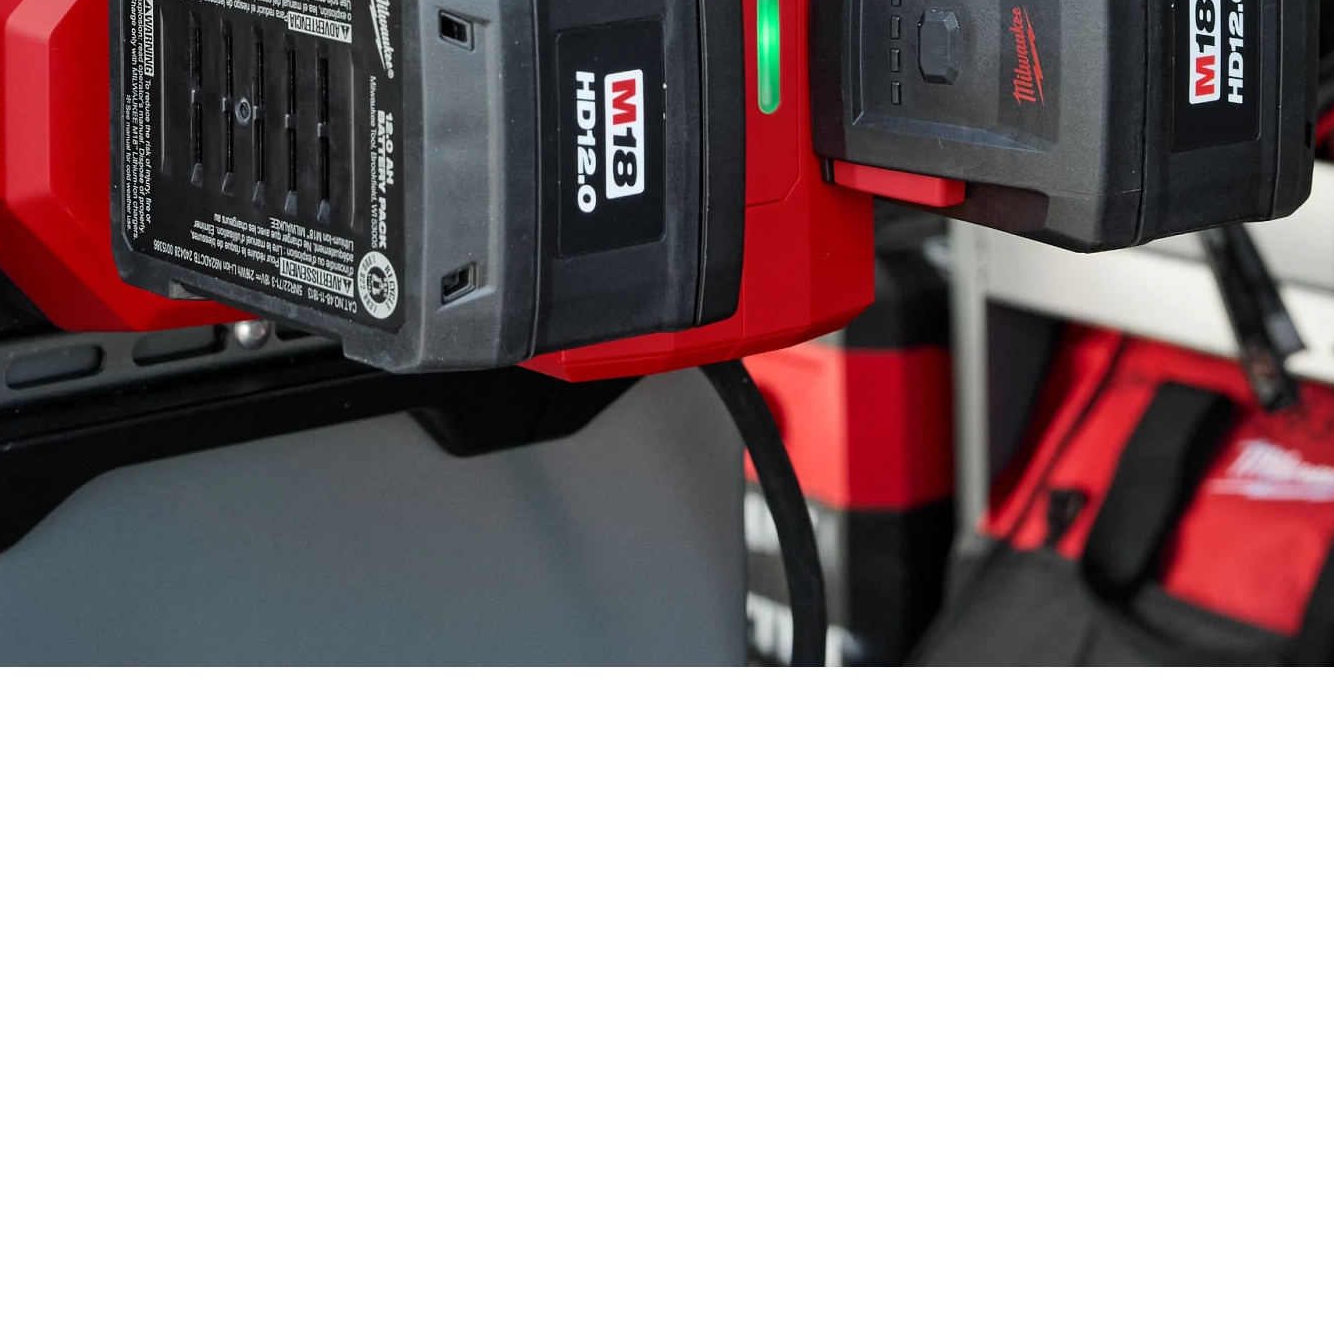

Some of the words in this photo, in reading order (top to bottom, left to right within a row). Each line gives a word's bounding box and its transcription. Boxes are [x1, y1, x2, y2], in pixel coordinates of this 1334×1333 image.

[290, 13, 339, 38] ADVERTENCIA
[144, 15, 153, 73] WARNING
[1009, 7, 1036, 105] Milwaukee
[145, 80, 151, 89] To
[576, 71, 596, 213] HD12.0
[611, 77, 638, 188] M18
[146, 158, 151, 168] of
[378, 110, 386, 193] BATTERY
[386, 157, 394, 184] AH
[139, 186, 145, 197] of
[146, 214, 150, 223] or
[371, 204, 377, 217] WI
[281, 259, 341, 290] AVERTISSEMENT
